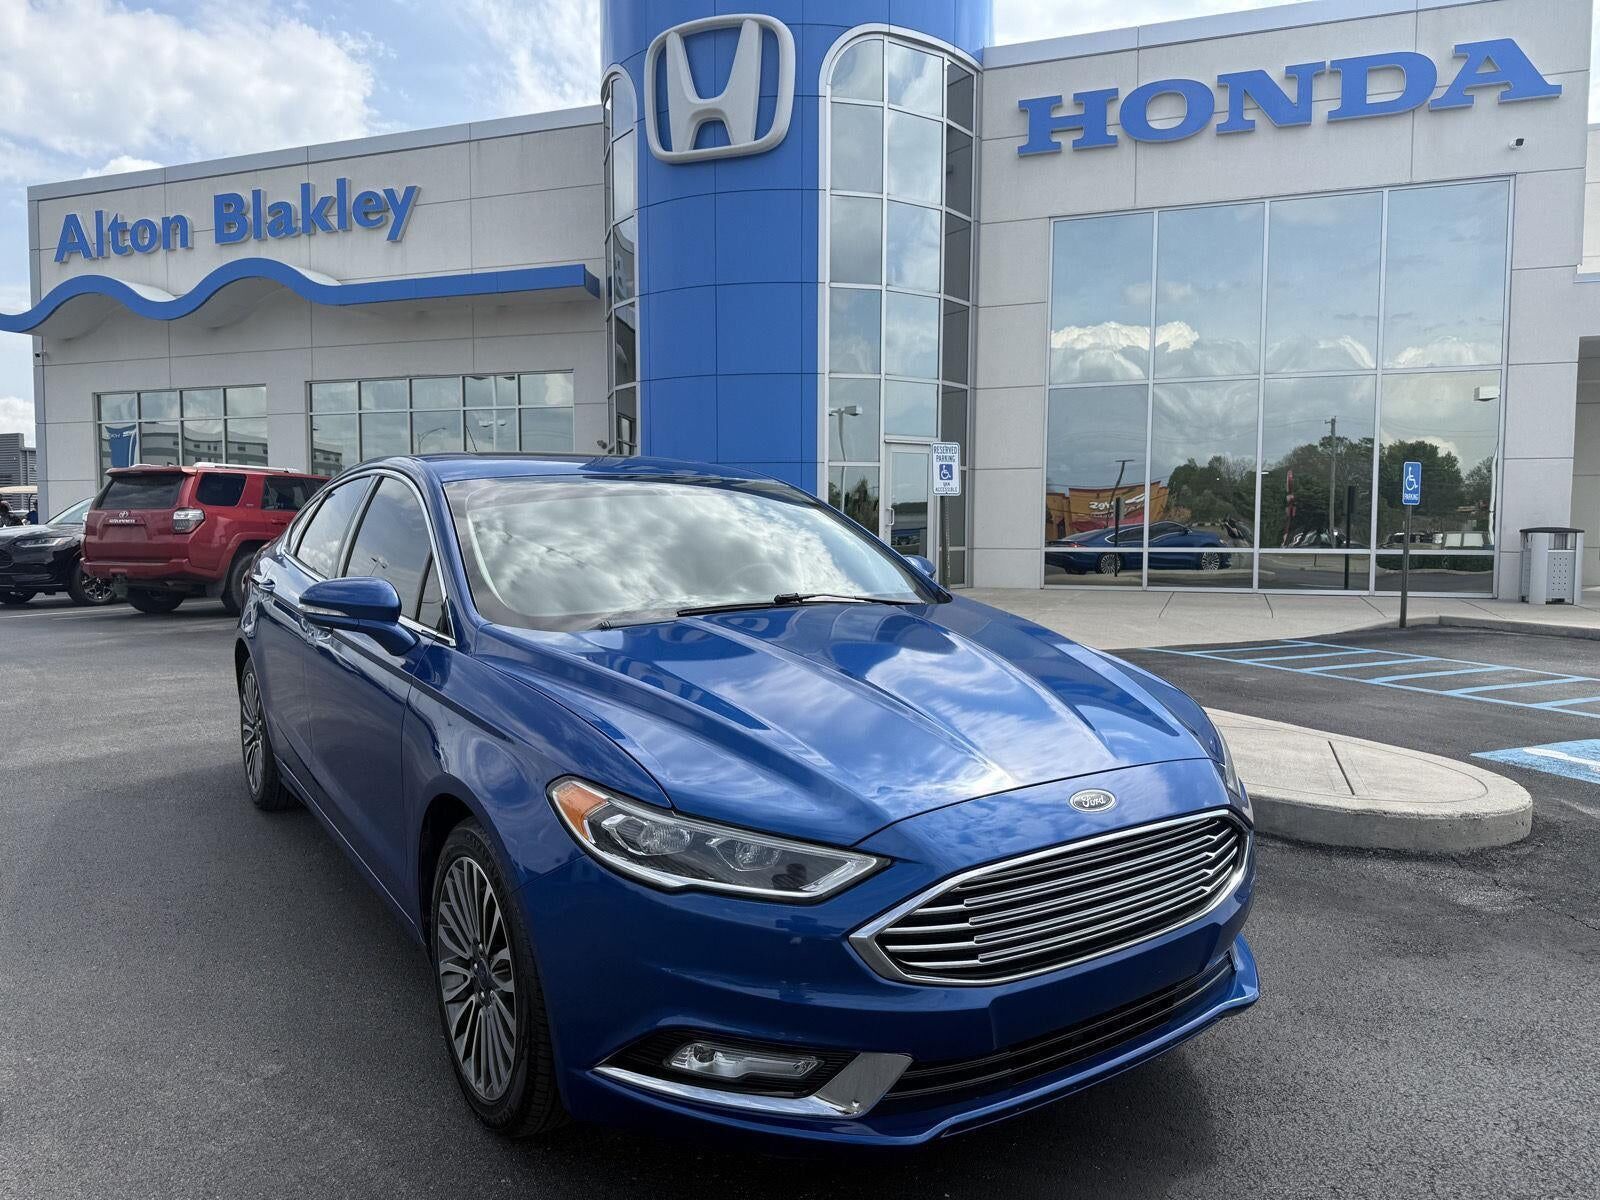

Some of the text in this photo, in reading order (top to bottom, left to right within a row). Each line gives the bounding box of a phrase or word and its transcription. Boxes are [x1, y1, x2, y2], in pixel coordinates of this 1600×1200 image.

[1017, 38, 1562, 157] HONDA
[54, 177, 419, 264] Alton Blakley
[933, 445, 957, 454] RESERVED
[1081, 795, 1106, 807] Ford
